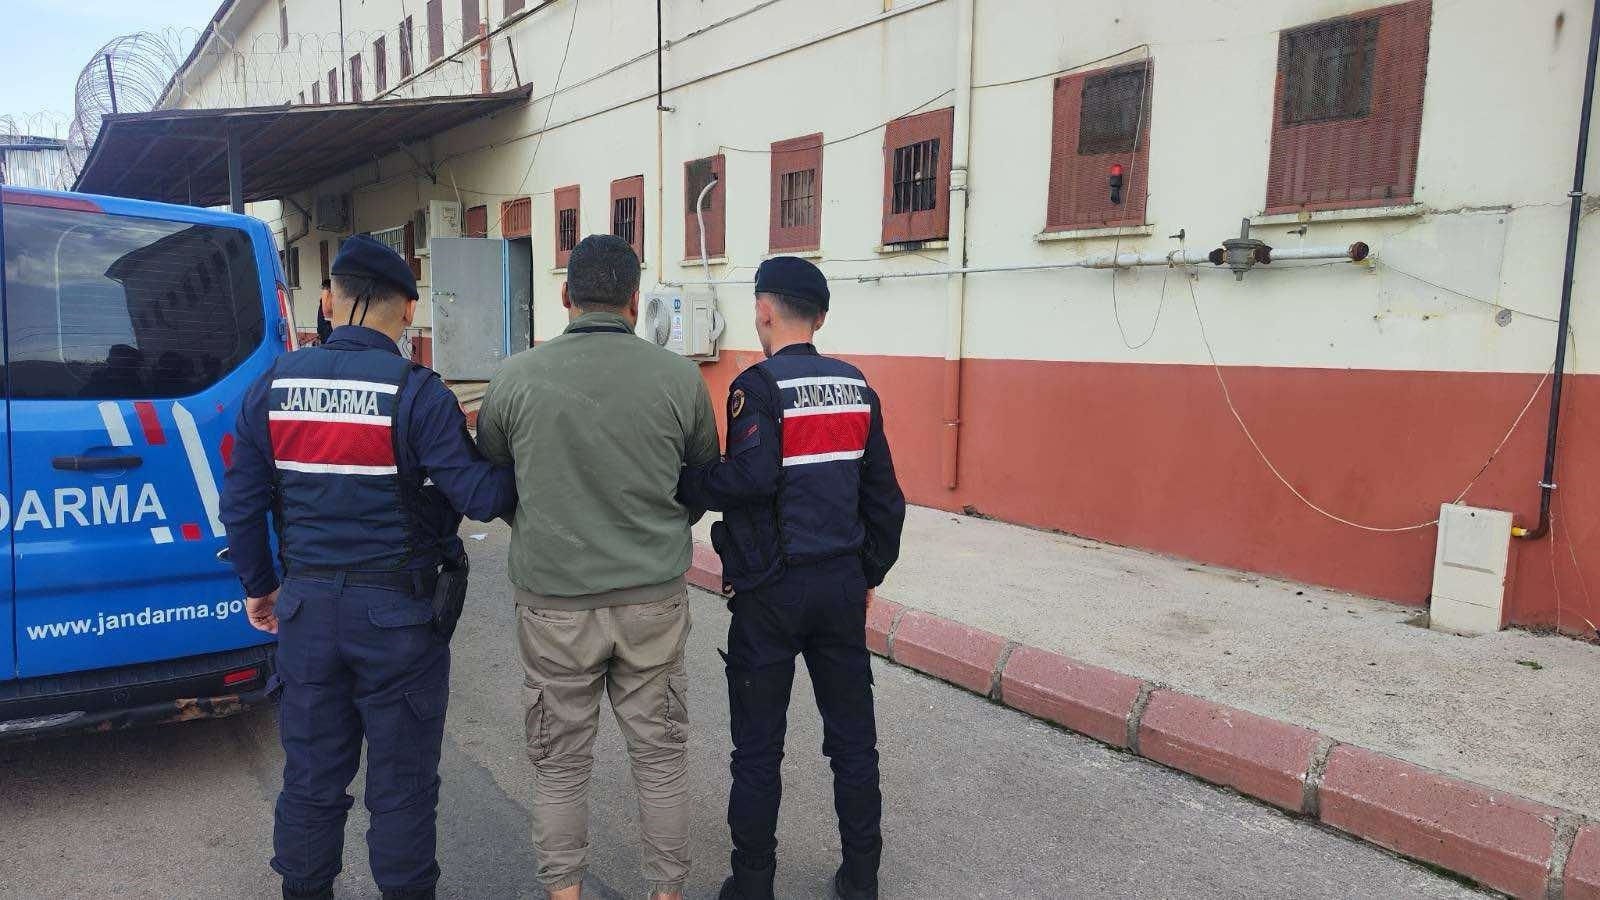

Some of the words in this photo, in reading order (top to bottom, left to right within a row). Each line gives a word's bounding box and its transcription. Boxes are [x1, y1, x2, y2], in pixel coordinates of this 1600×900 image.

[280, 387, 379, 416] JANDARMA
[793, 384, 864, 408] JANDARMA
[0, 483, 166, 531] ARMA
